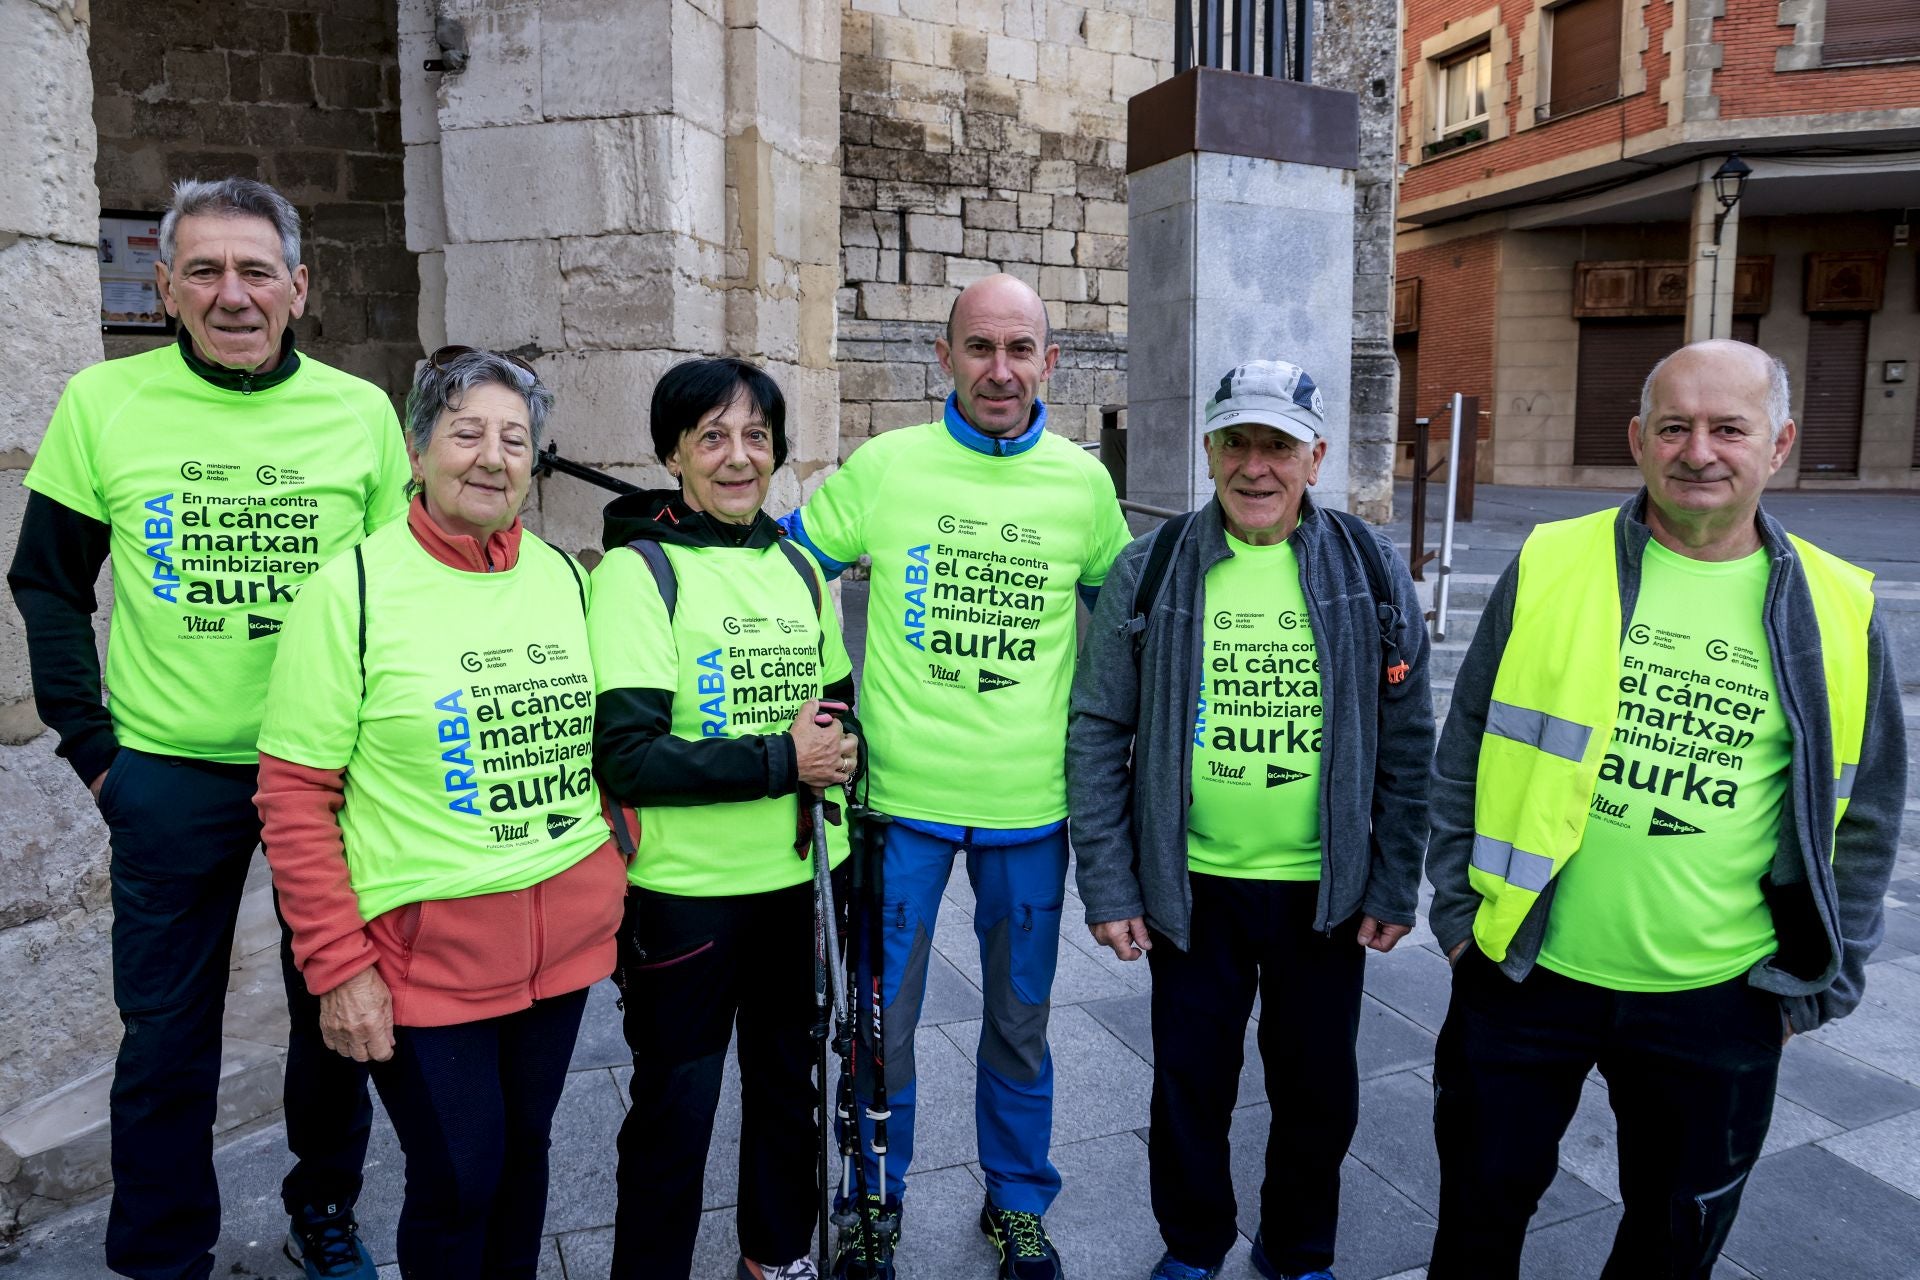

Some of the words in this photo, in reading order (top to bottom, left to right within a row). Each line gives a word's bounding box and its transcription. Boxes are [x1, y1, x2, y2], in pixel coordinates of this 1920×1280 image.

[182, 492, 201, 504] En
[206, 496, 266, 506] marcha
[270, 496, 318, 507] contra
[181, 506, 211, 527] el
[218, 508, 319, 529] cáncer
[144, 493, 180, 604] ARABA
[182, 531, 318, 554] martxan
[182, 556, 319, 574] minbiziaren
[937, 544, 953, 556] En
[957, 548, 1007, 564] marcha
[1010, 556, 1049, 570] contra
[935, 559, 959, 578] el
[965, 563, 1048, 590] cáncer
[186, 575, 304, 605] aurk
[905, 544, 930, 652] ARABA
[934, 582, 1045, 612] martxan
[183, 616, 225, 632] Vital
[932, 604, 1040, 630] minbiziaren
[729, 647, 745, 658] En
[749, 645, 791, 657] marcha
[930, 629, 1036, 662] aurka
[1213, 641, 1230, 651] En
[1234, 642, 1288, 652] marcha
[731, 659, 755, 680] el
[760, 657, 817, 678] cáncer
[929, 664, 960, 681] Vital
[1212, 653, 1238, 672] el
[1246, 654, 1320, 673] cánce
[470, 685, 491, 698] En
[494, 678, 548, 696] marcha
[550, 673, 588, 686] contra
[1214, 676, 1322, 697] martxa
[1624, 656, 1644, 670] En
[1648, 662, 1711, 685] marcha
[1716, 678, 1769, 701] contra
[697, 648, 728, 737] RABA
[733, 680, 818, 705] martxan
[1619, 673, 1648, 696] el
[1656, 684, 1765, 725] cáncer
[476, 698, 504, 723] el
[511, 690, 592, 718] cáncer
[732, 705, 798, 725] minbizia
[1213, 700, 1322, 718] minbiziare
[479, 714, 593, 750] martxan
[1618, 700, 1755, 748] martxan
[434, 689, 482, 816] ARABA
[483, 739, 592, 774] minbiziaren
[1611, 726, 1742, 770] minbiziaren
[1208, 761, 1246, 779] Vital
[1598, 753, 1738, 809] aurka
[489, 764, 592, 813] aurka
[490, 821, 529, 842] Vital
[873, 992, 881, 1039] LEKI
